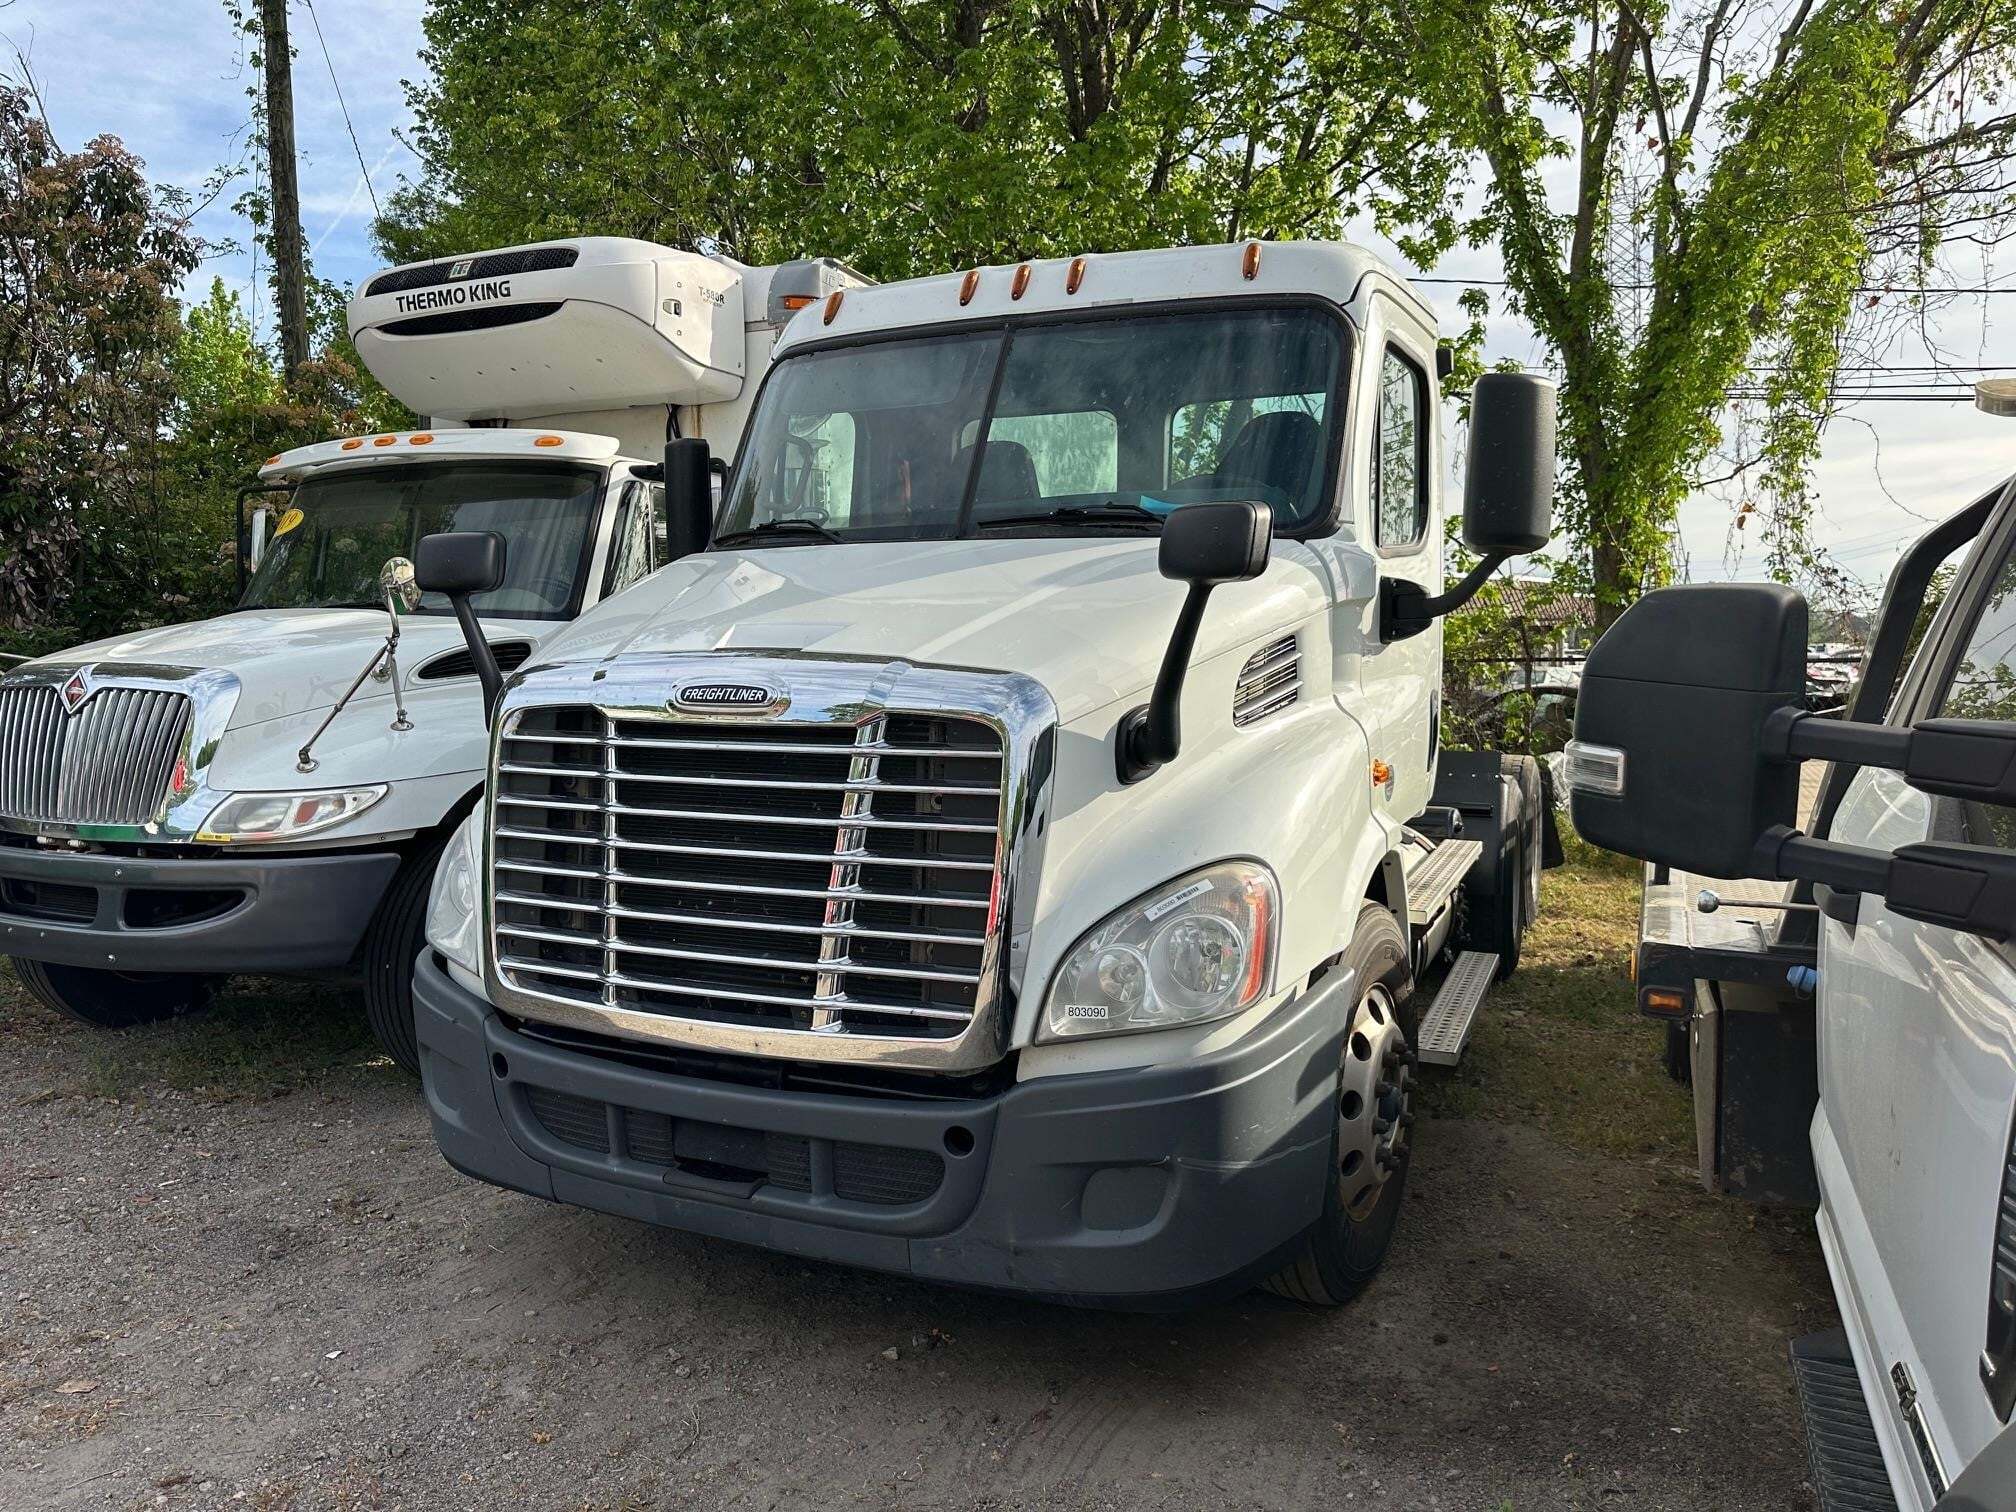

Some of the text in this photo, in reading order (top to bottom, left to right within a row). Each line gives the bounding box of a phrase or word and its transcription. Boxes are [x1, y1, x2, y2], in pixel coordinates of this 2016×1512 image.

[396, 280, 511, 312] THERMO KING
[683, 687, 764, 701] FREIGHTLINER
[1068, 1006, 1106, 1018] 803090
